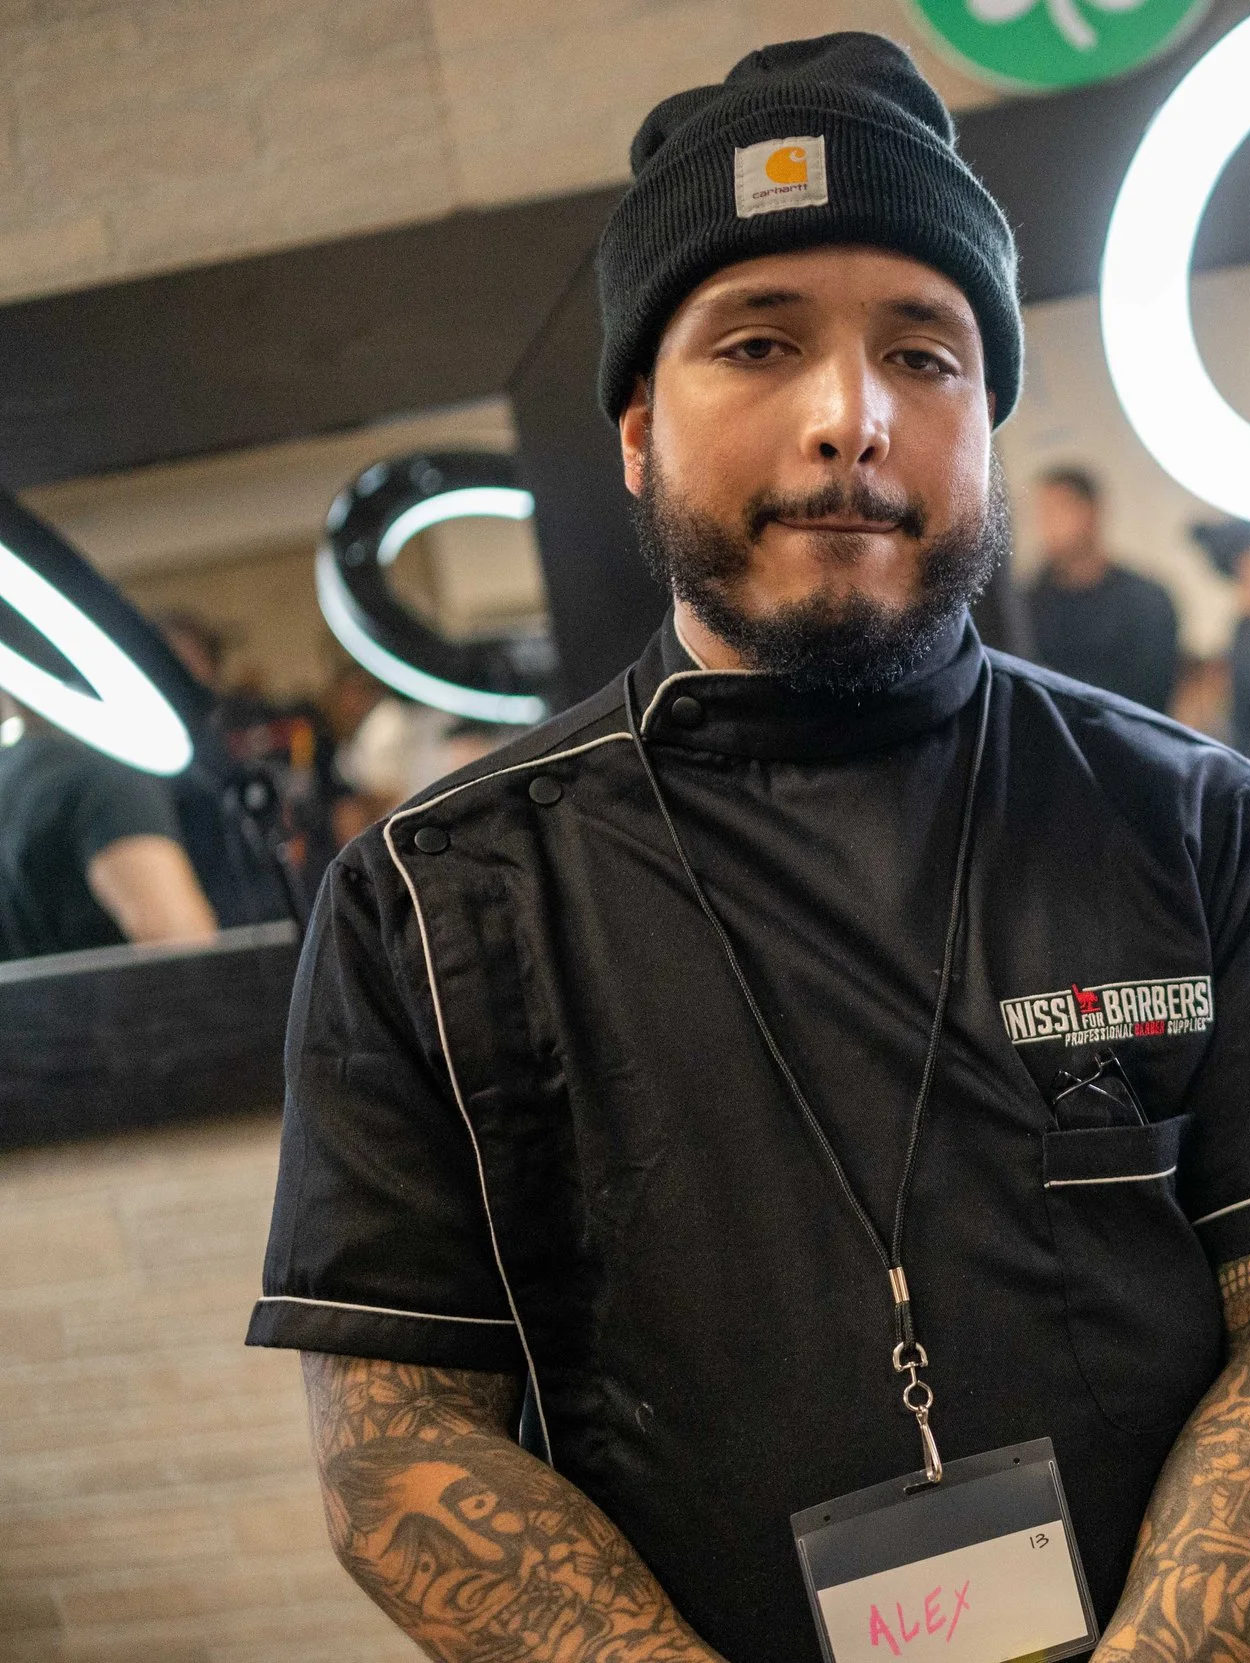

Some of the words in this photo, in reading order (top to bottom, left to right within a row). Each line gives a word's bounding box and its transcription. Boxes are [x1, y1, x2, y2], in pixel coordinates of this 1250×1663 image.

[752, 183, 808, 199] carhartt
[1005, 994, 1078, 1040] NISSI
[1081, 1012, 1105, 1029] FOR
[1102, 982, 1209, 1025] BARBERS
[1065, 1027, 1133, 1047] PROFESSIONAL
[1134, 1021, 1165, 1037] BARBER
[1167, 1018, 1207, 1035] SUPPLIES
[1029, 1533, 1050, 1549] 13
[869, 1579, 971, 1656] ALEX
